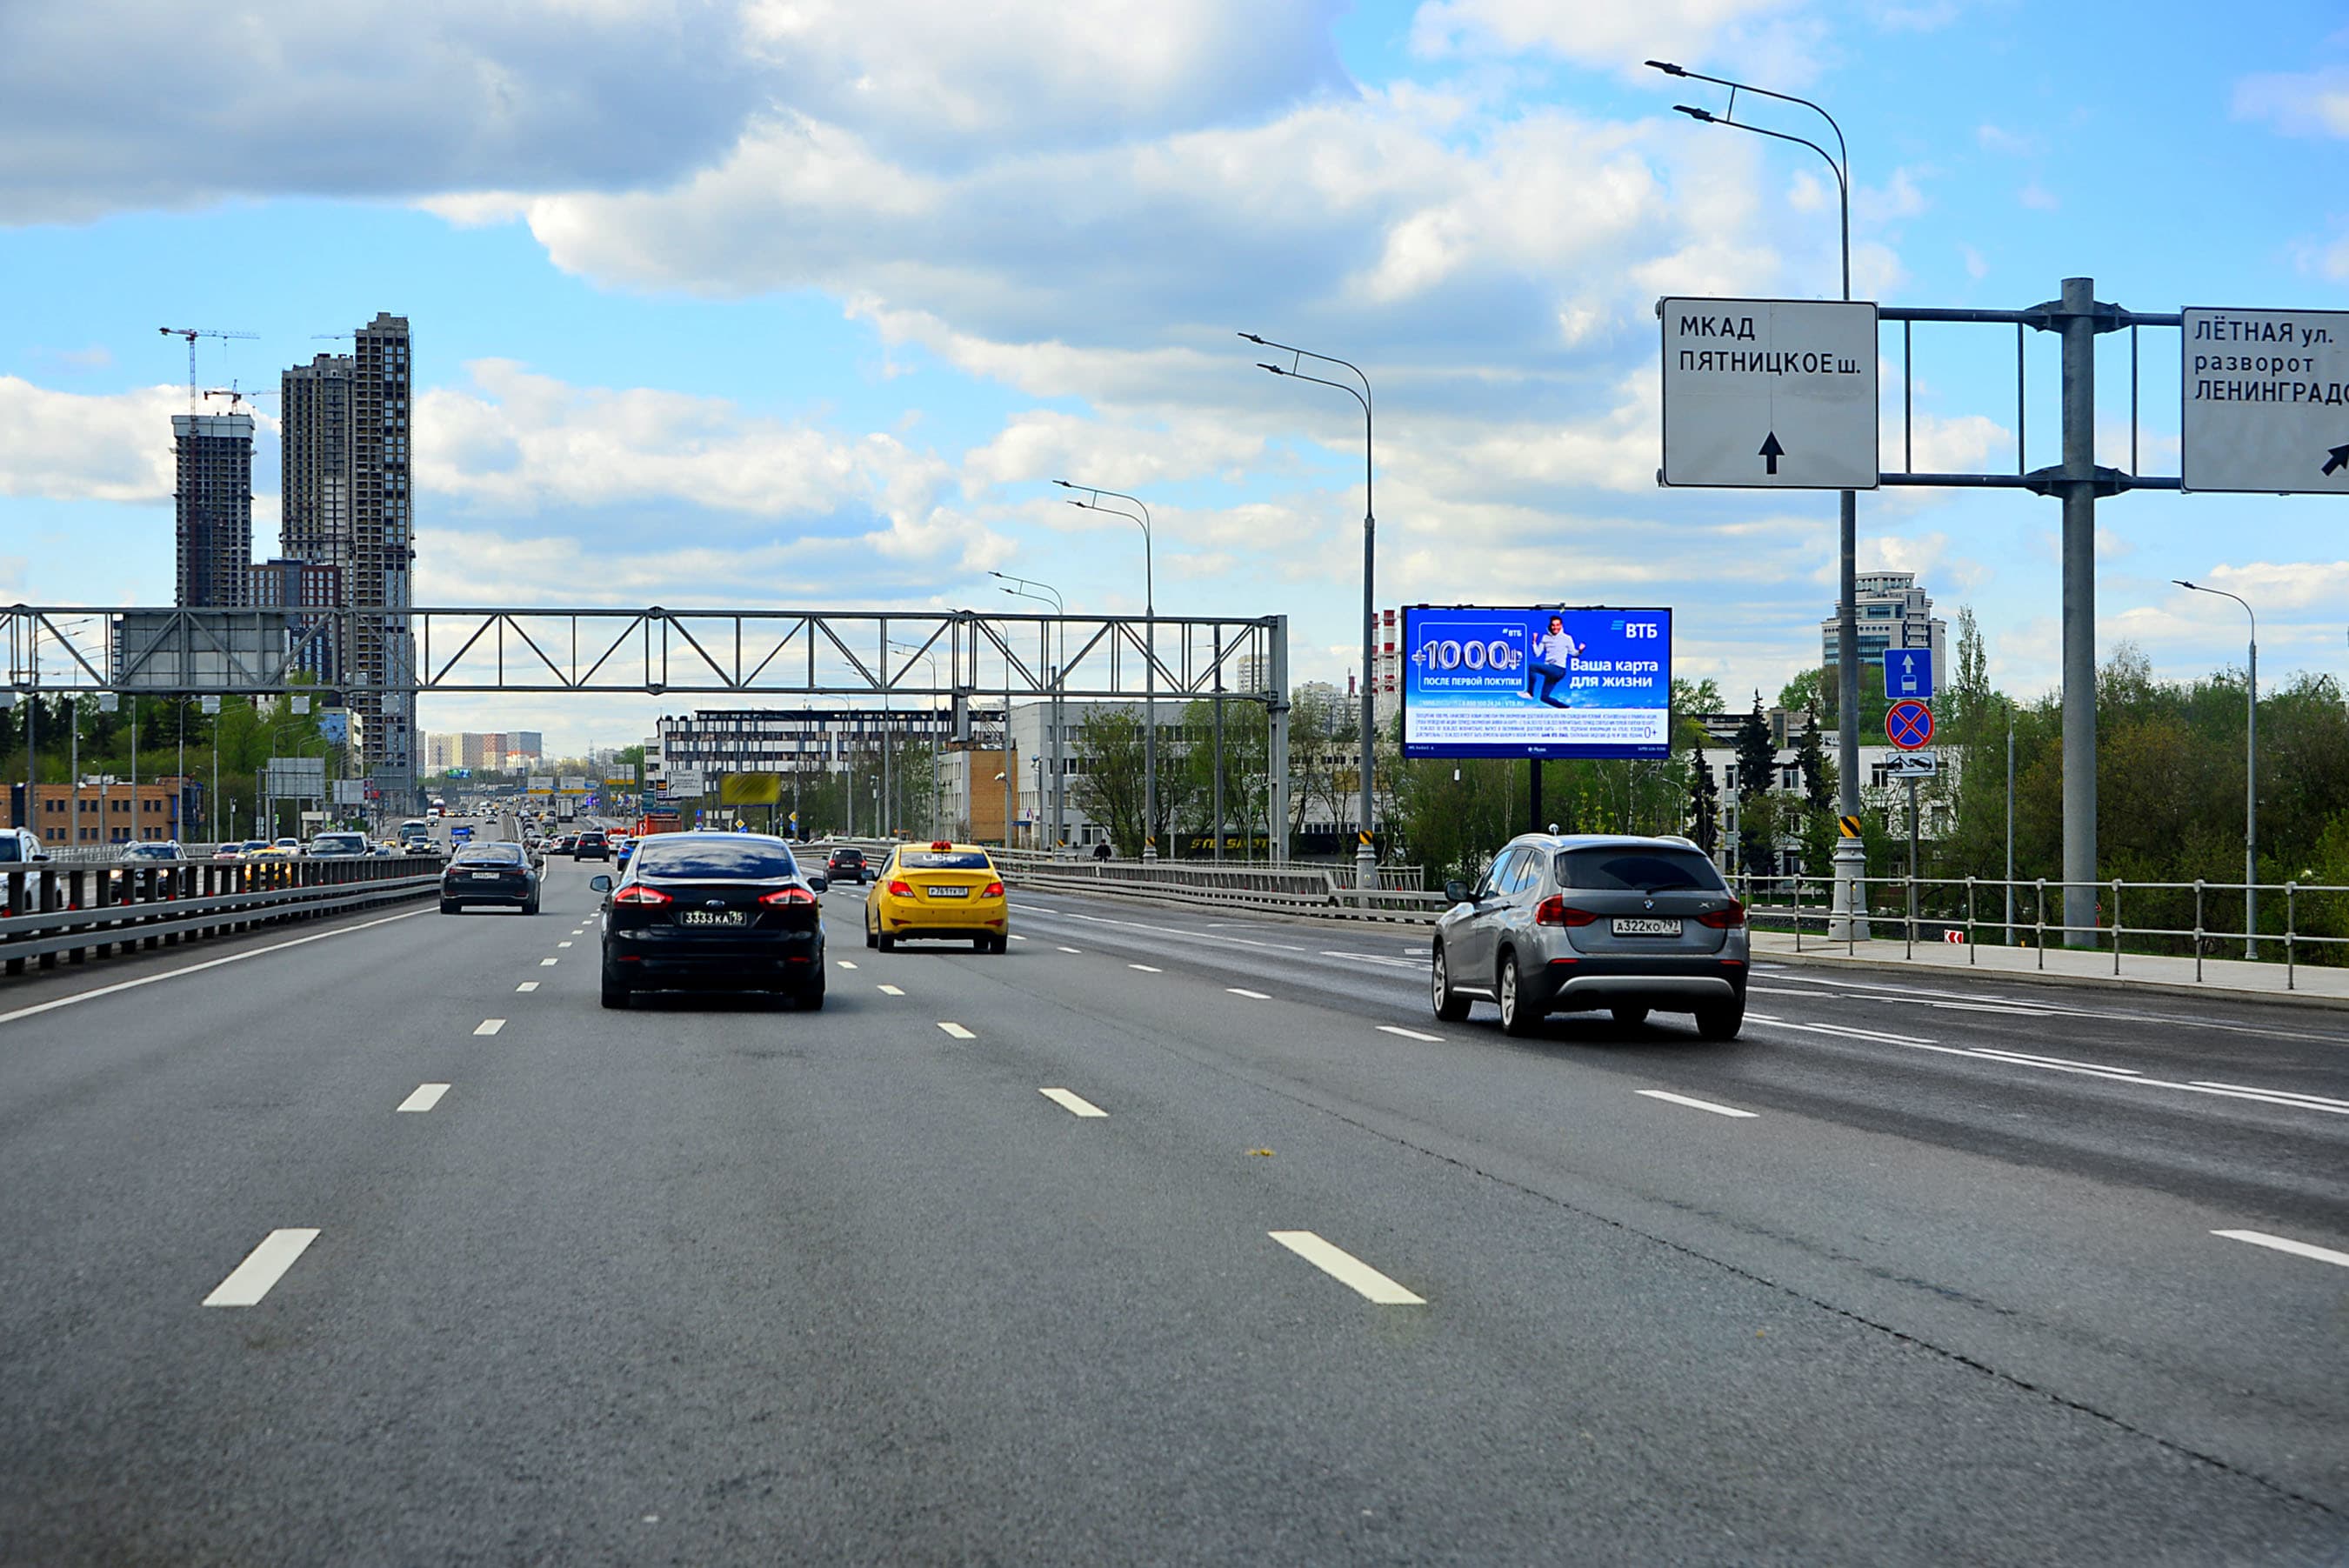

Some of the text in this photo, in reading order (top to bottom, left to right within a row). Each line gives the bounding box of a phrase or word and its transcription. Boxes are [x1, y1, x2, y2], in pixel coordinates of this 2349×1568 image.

[1680, 316, 1755, 341] МКАД
[2195, 316, 2333, 348] ЛЁТНАЯ ул.
[1680, 350, 1861, 376] ПЯТНИЦКОЕ ш.
[2195, 355, 2313, 377] разворот
[1625, 623, 1658, 638] ВТБ
[1570, 657, 1658, 675] Ваша карта
[1424, 676, 1522, 686] ПОСЛЕ ПЕРВОЙ ПОКУПКИ
[1569, 677, 1652, 689] для жизни
[923, 854, 964, 863] Uber
[1616, 920, 1661, 932] А322КО
